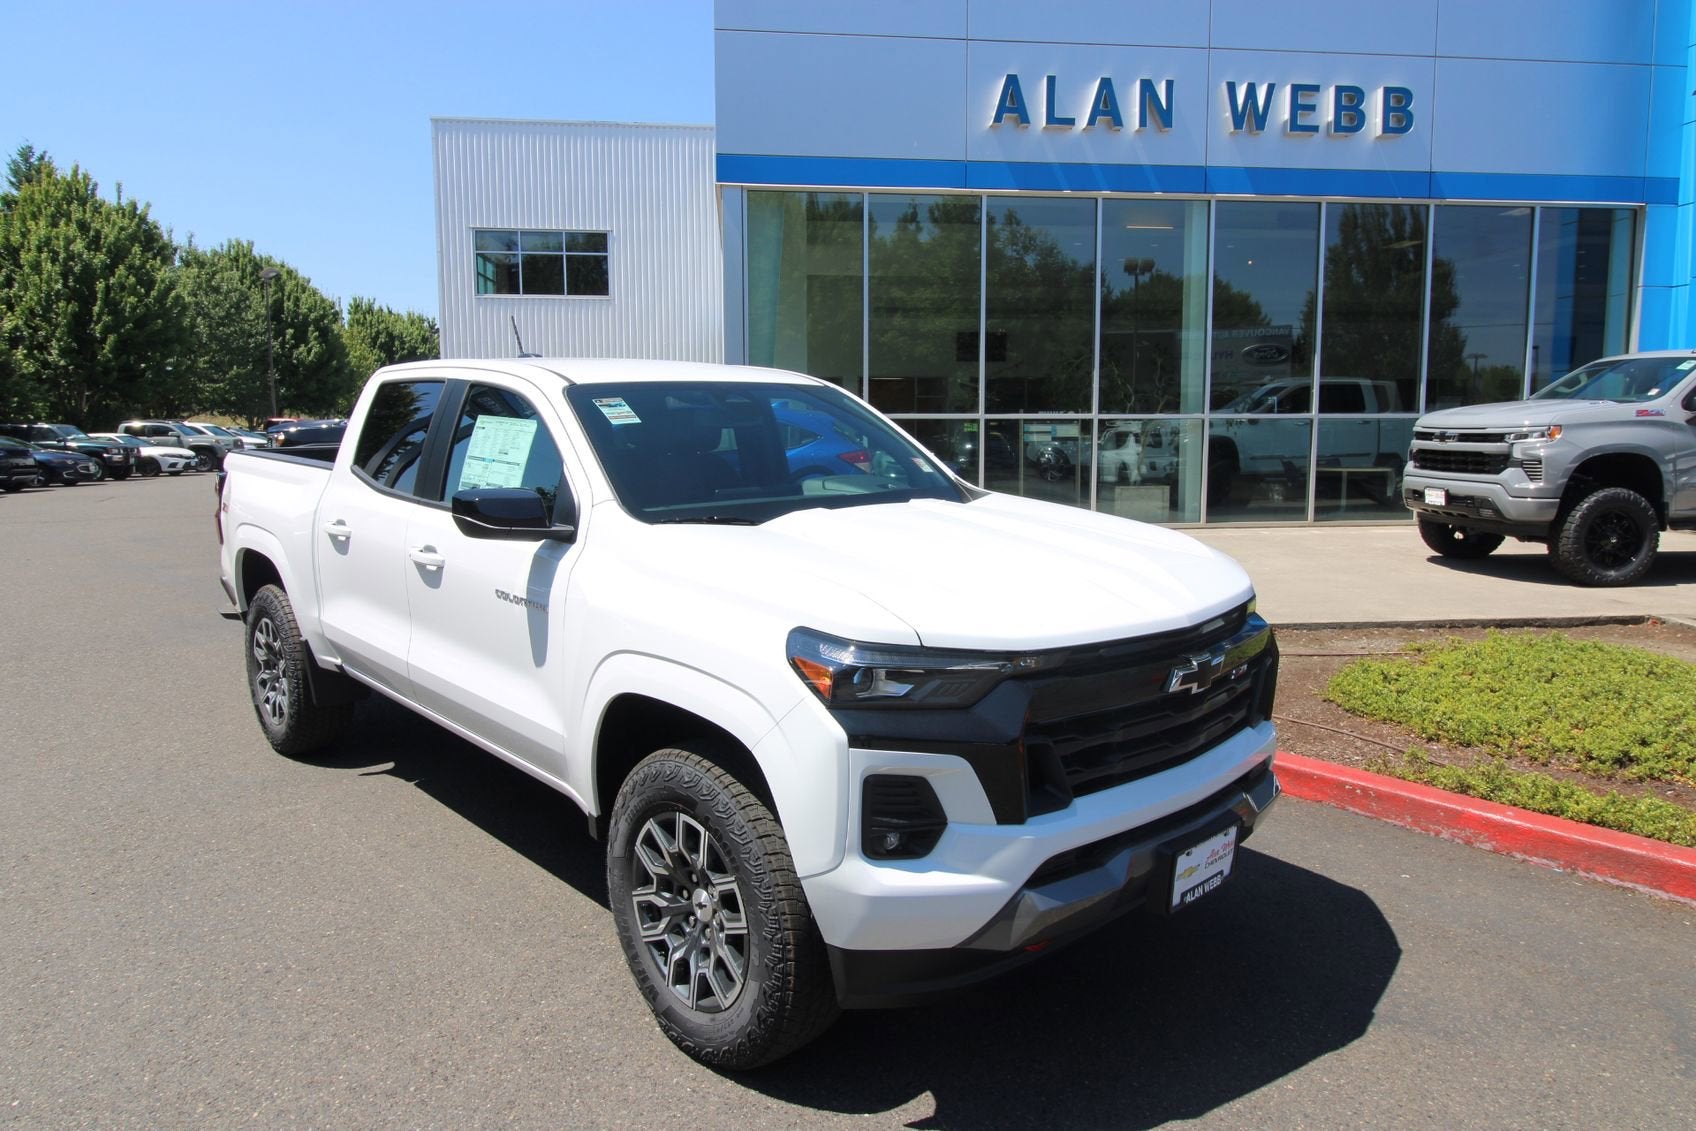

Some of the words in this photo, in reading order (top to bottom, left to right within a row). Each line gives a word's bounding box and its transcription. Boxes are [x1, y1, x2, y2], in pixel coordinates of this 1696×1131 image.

[991, 74, 1174, 131] ALAN
[1225, 80, 1415, 136] WEBB
[1185, 885, 1203, 904] ALAN
[1204, 874, 1222, 893] WEBB
